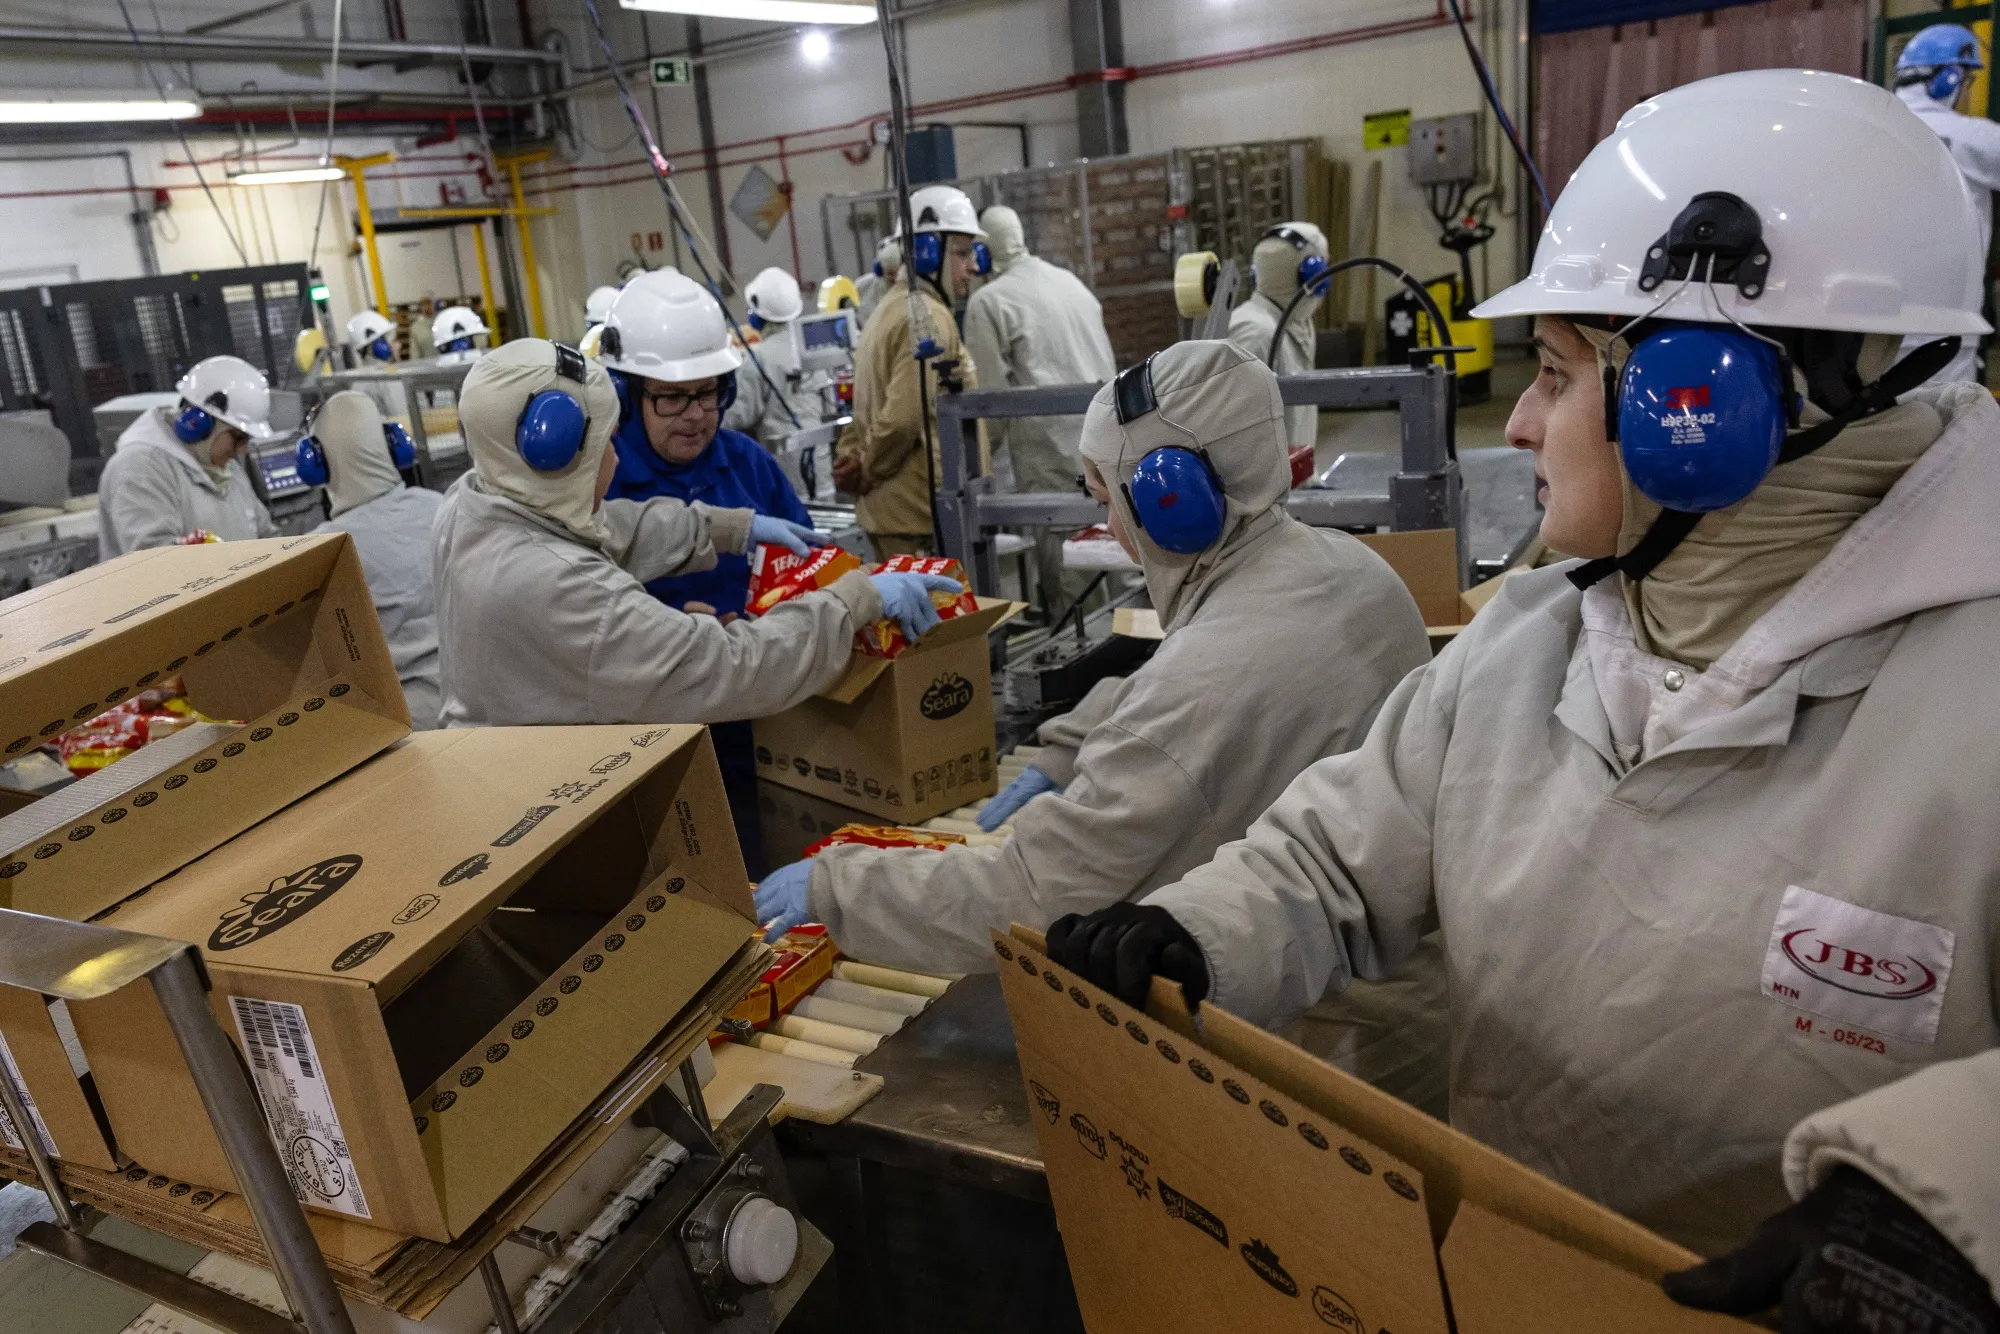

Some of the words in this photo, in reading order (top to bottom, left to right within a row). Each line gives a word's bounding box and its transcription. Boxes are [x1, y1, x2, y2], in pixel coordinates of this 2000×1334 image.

[1667, 385, 1709, 408] 3M
[923, 688, 970, 714] Seara
[571, 778, 609, 804] marba
[219, 862, 358, 946] Seara
[397, 899, 434, 922] LeBon
[336, 934, 383, 968] Rezende
[1805, 939, 1908, 985] JBS
[1773, 982, 1800, 1000] MTN
[1795, 1016, 1812, 1033] M
[1833, 1028, 1887, 1055] 05/23
[295, 1142, 321, 1189] BRASIL
